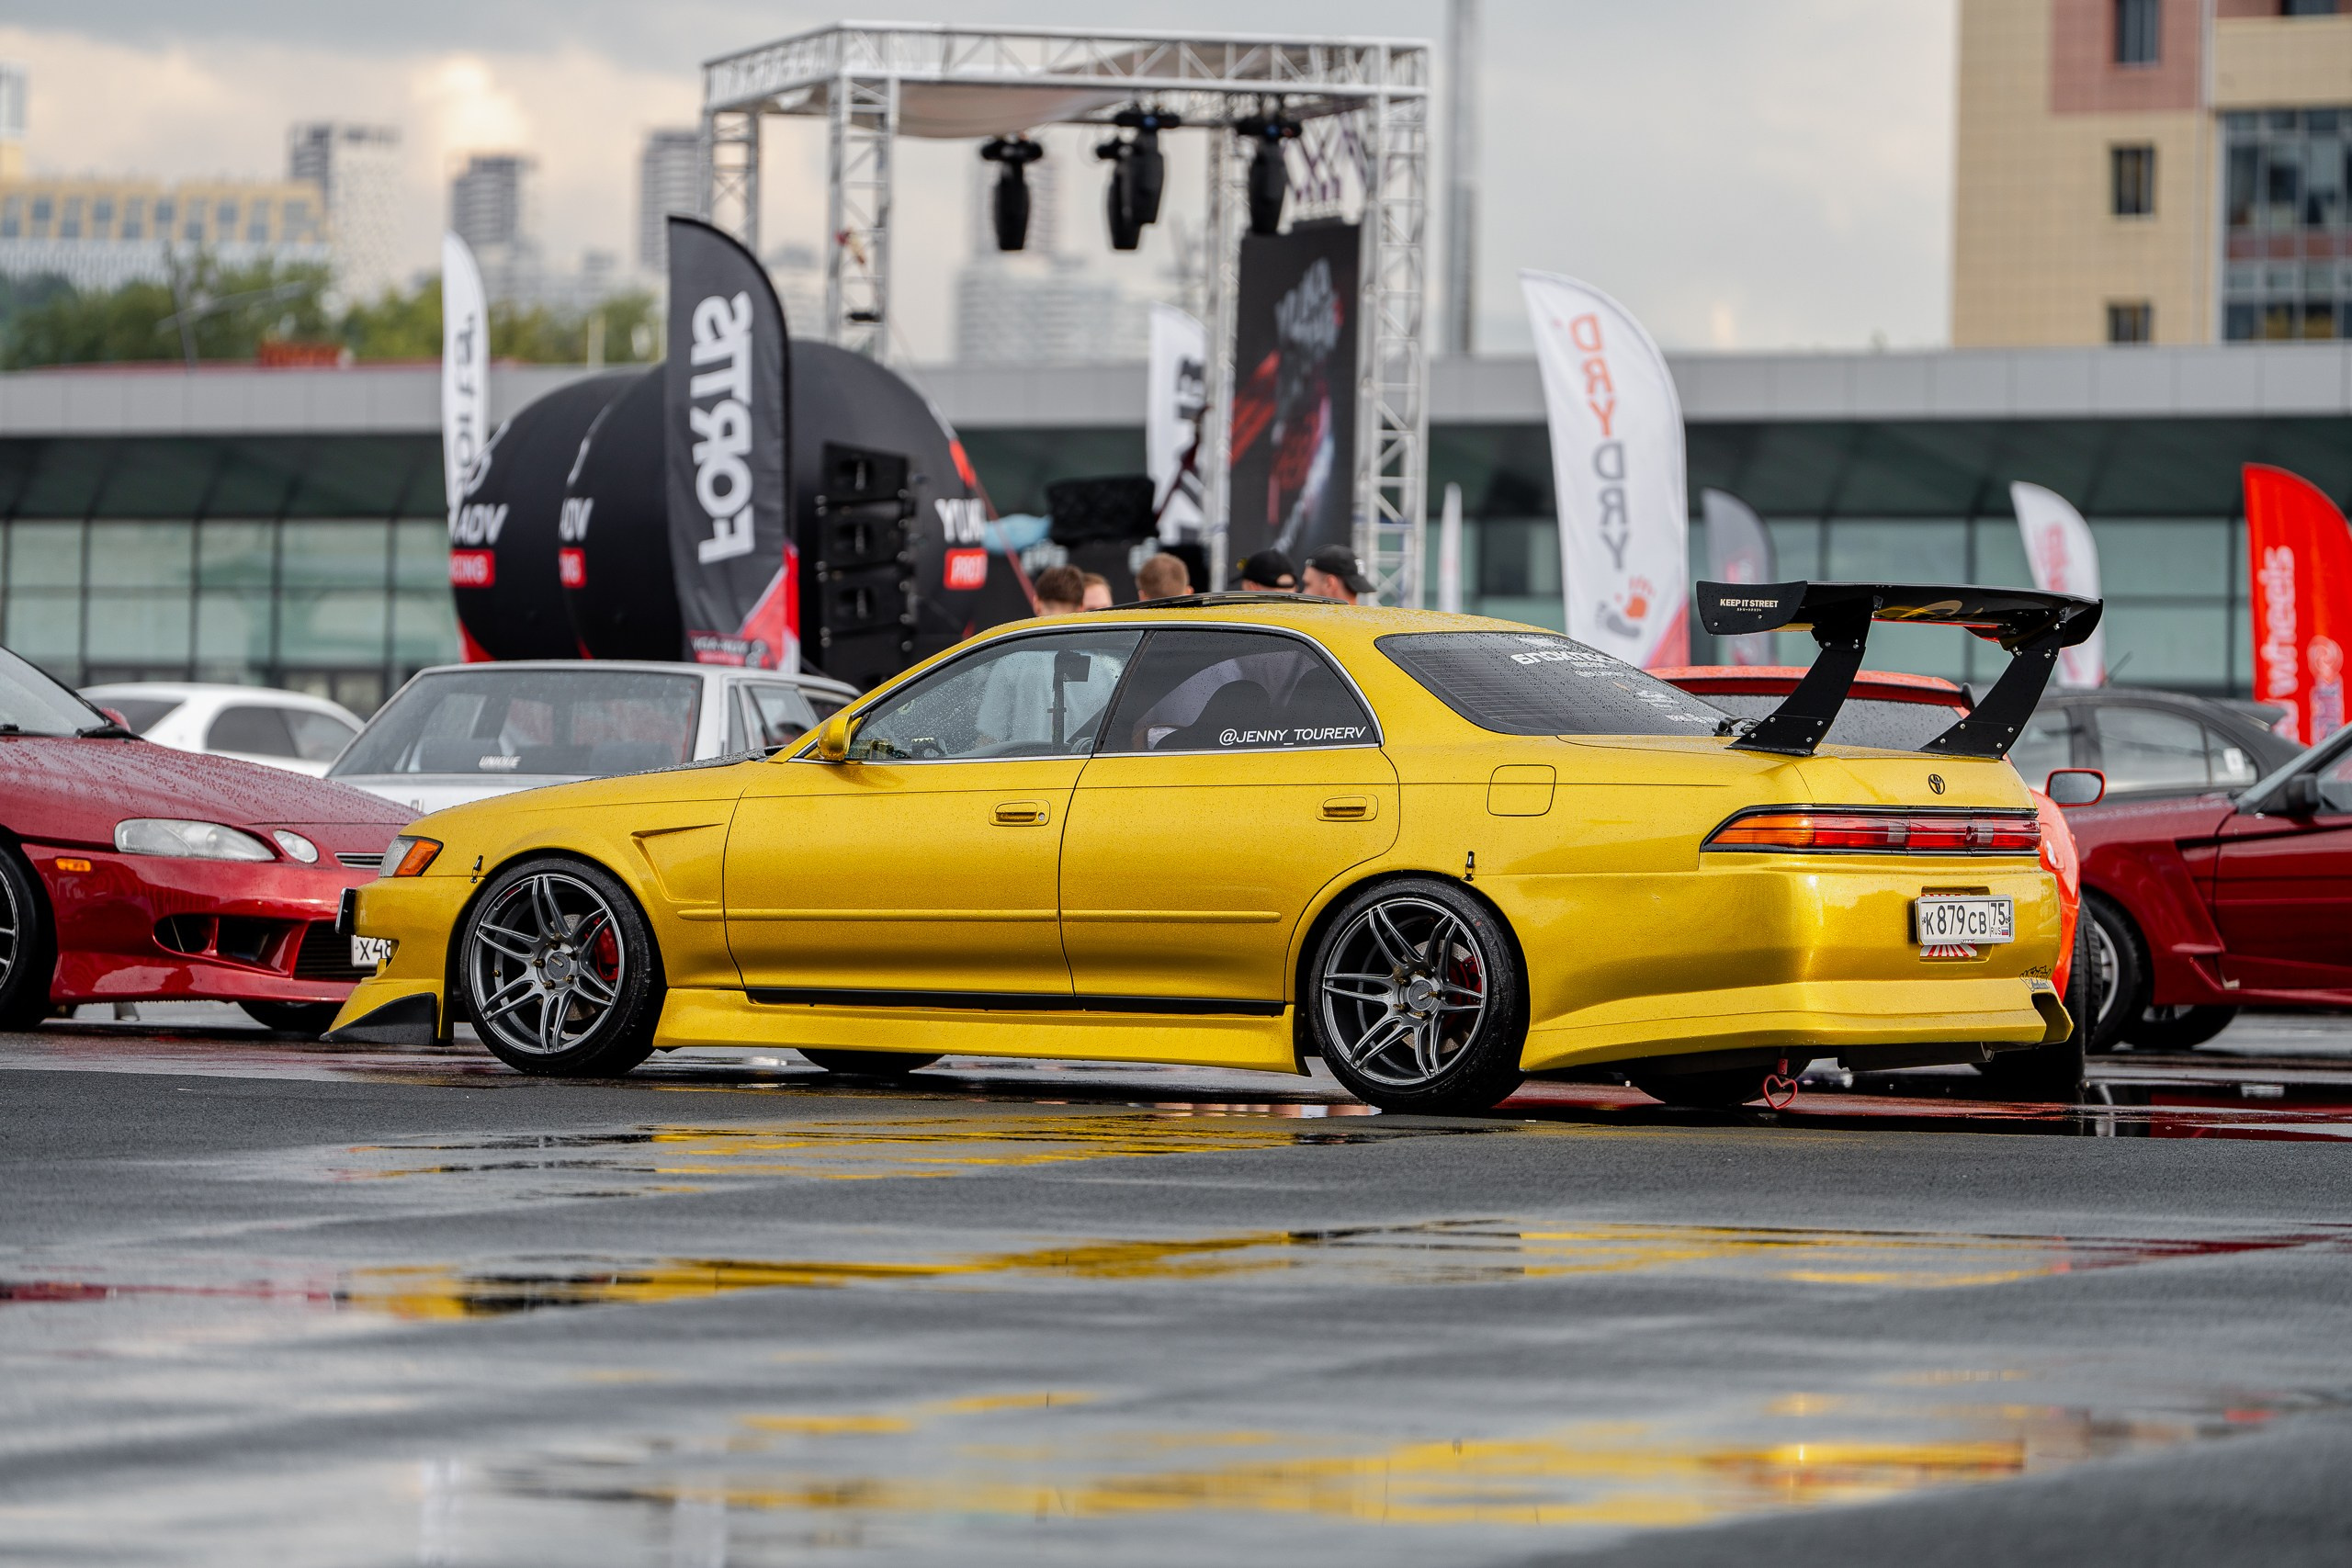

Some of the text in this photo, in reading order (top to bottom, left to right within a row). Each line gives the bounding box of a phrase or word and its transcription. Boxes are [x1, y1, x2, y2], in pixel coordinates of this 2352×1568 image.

[1720, 598, 1779, 608] KEEP IT STREET
[1219, 726, 1366, 746] @JENNY_TOURERV
[1990, 902, 2006, 926] 75
[1991, 927, 2002, 935] RUS
